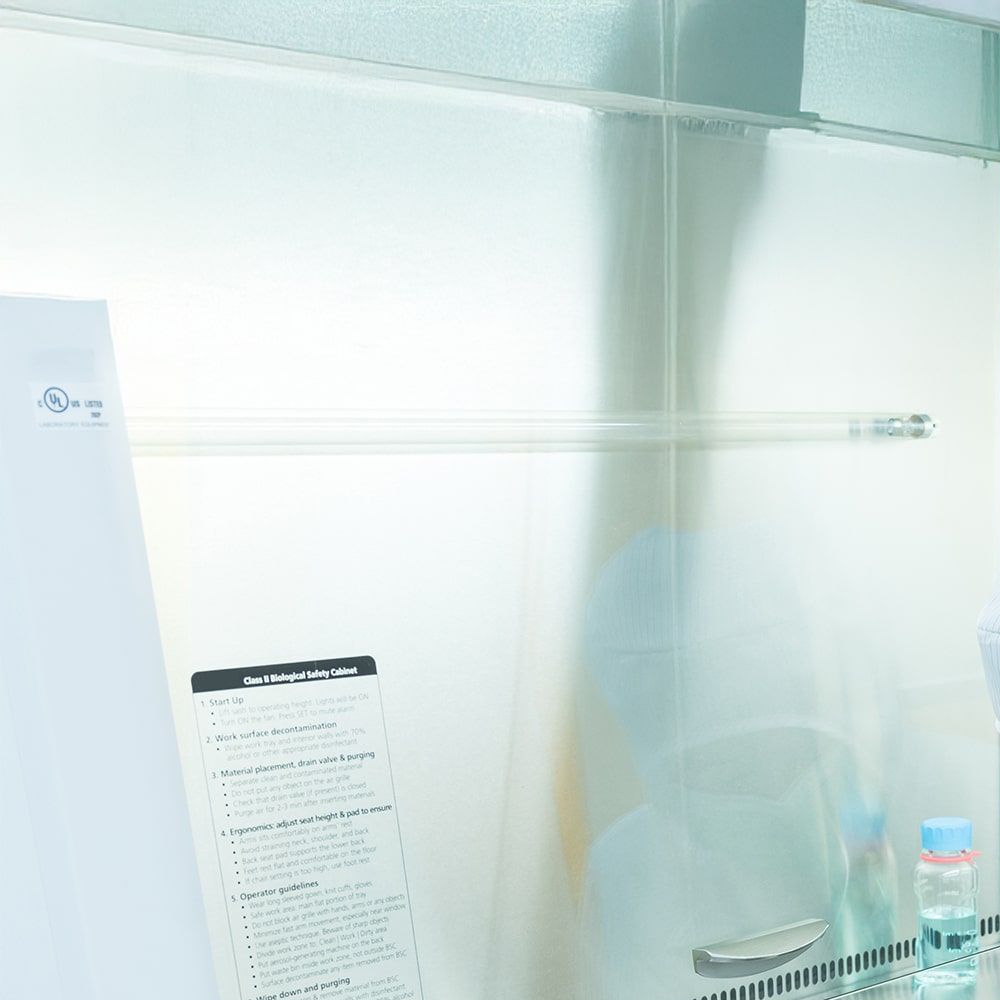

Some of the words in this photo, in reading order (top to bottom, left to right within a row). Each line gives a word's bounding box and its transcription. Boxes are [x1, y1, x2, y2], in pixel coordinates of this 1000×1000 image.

[243, 676, 262, 685] Class
[264, 674, 269, 683] II
[270, 671, 305, 682] Biological
[307, 669, 329, 678] Safety
[330, 666, 357, 676] Cabinet
[209, 698, 229, 706] Start
[231, 696, 244, 705] Up
[214, 732, 237, 742] Work
[239, 730, 269, 739] surface
[271, 722, 337, 735] decontamination
[220, 766, 252, 777] Material
[255, 761, 296, 774] placement,
[298, 758, 317, 767] drain
[319, 756, 337, 764] valve
[347, 751, 375, 762] purging
[276, 818, 297, 828] adjust
[299, 816, 313, 824] seat
[315, 812, 337, 821] height
[339, 810, 345, 818] &
[346, 808, 359, 818] pad
[370, 804, 392, 813] ensure
[240, 888, 276, 901] Operator
[279, 881, 318, 895] guidelines
[279, 989, 301, 999] down
[304, 983, 318, 993] and
[320, 977, 350, 991] purging
